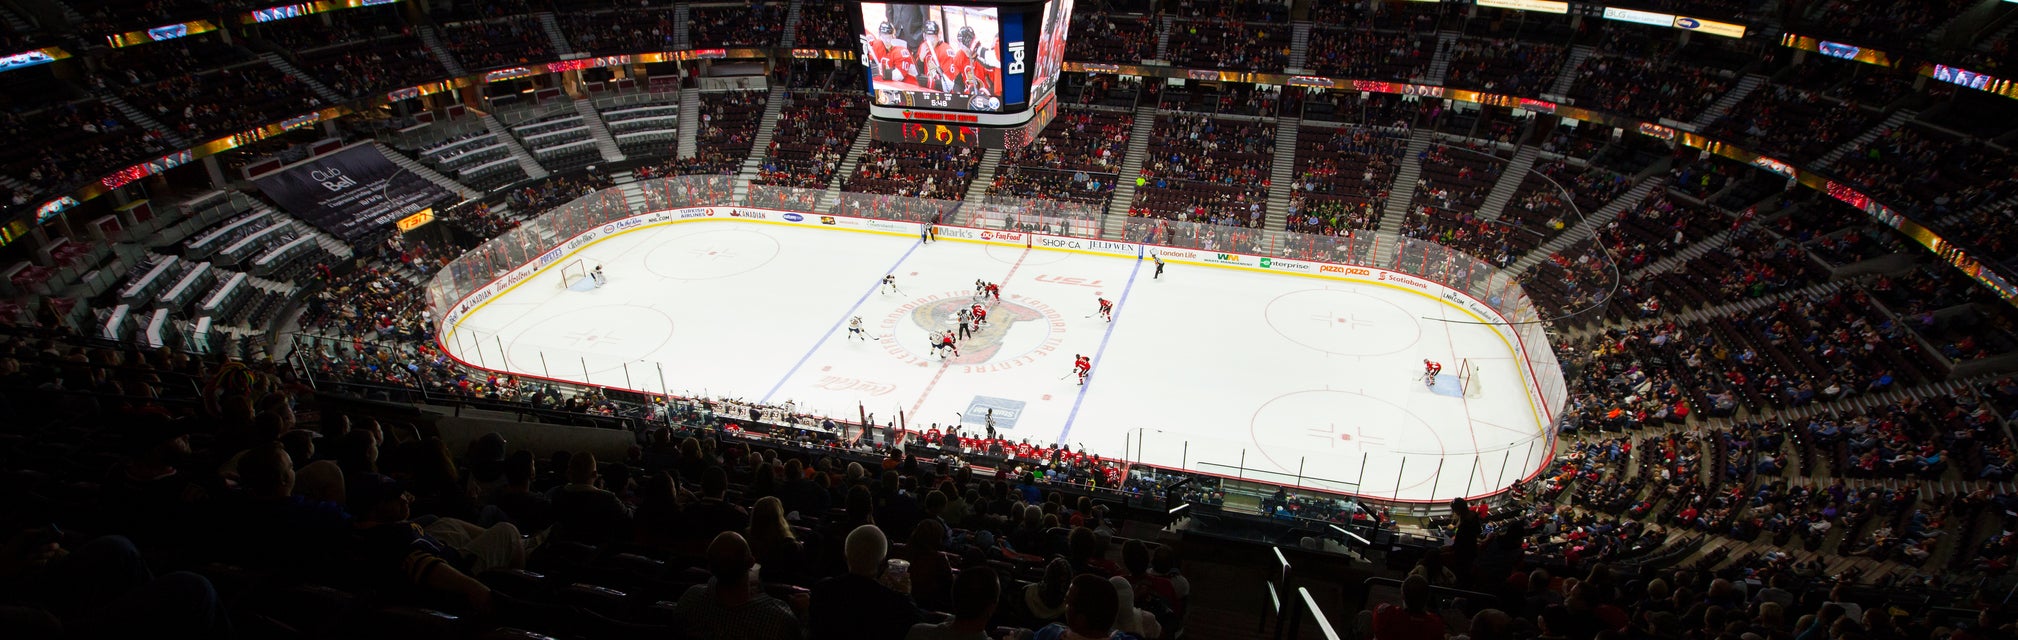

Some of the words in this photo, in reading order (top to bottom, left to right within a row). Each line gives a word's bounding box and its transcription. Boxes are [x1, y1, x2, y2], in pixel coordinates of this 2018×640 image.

[860, 34, 870, 67] Bell
[1008, 41, 1025, 75] Bell
[311, 166, 341, 182] Club
[321, 174, 357, 192] Bell
[739, 210, 766, 220] CANADIAN
[939, 226, 974, 239] Mark's
[1160, 249, 1183, 259] London
[1184, 251, 1197, 260] Life
[1217, 253, 1239, 262] WM
[1319, 264, 1344, 275] pizza
[1345, 266, 1370, 277] pizza
[494, 281, 508, 293] Tim
[507, 269, 531, 287] Hortons
[1388, 274, 1428, 290] Scotiabank
[466, 288, 492, 308] CANADIAN
